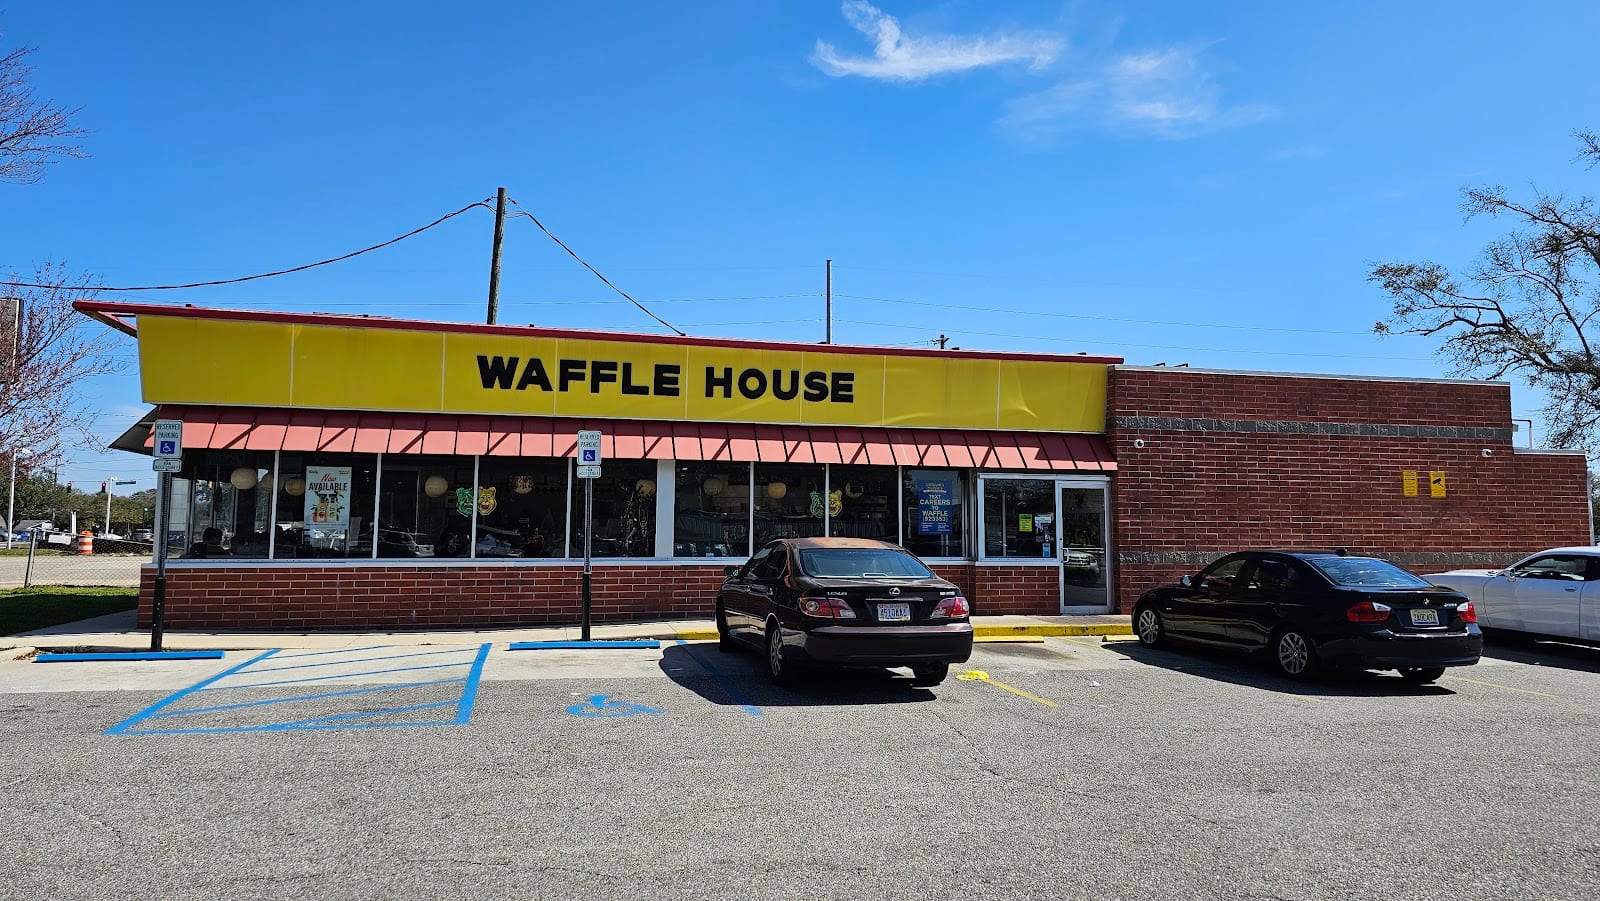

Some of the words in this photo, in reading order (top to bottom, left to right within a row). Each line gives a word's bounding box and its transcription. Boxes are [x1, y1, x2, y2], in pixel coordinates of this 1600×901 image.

[476, 355, 681, 397] WAFFLE
[704, 365, 855, 403] HOUSE
[308, 482, 349, 491] AVAILABLE
